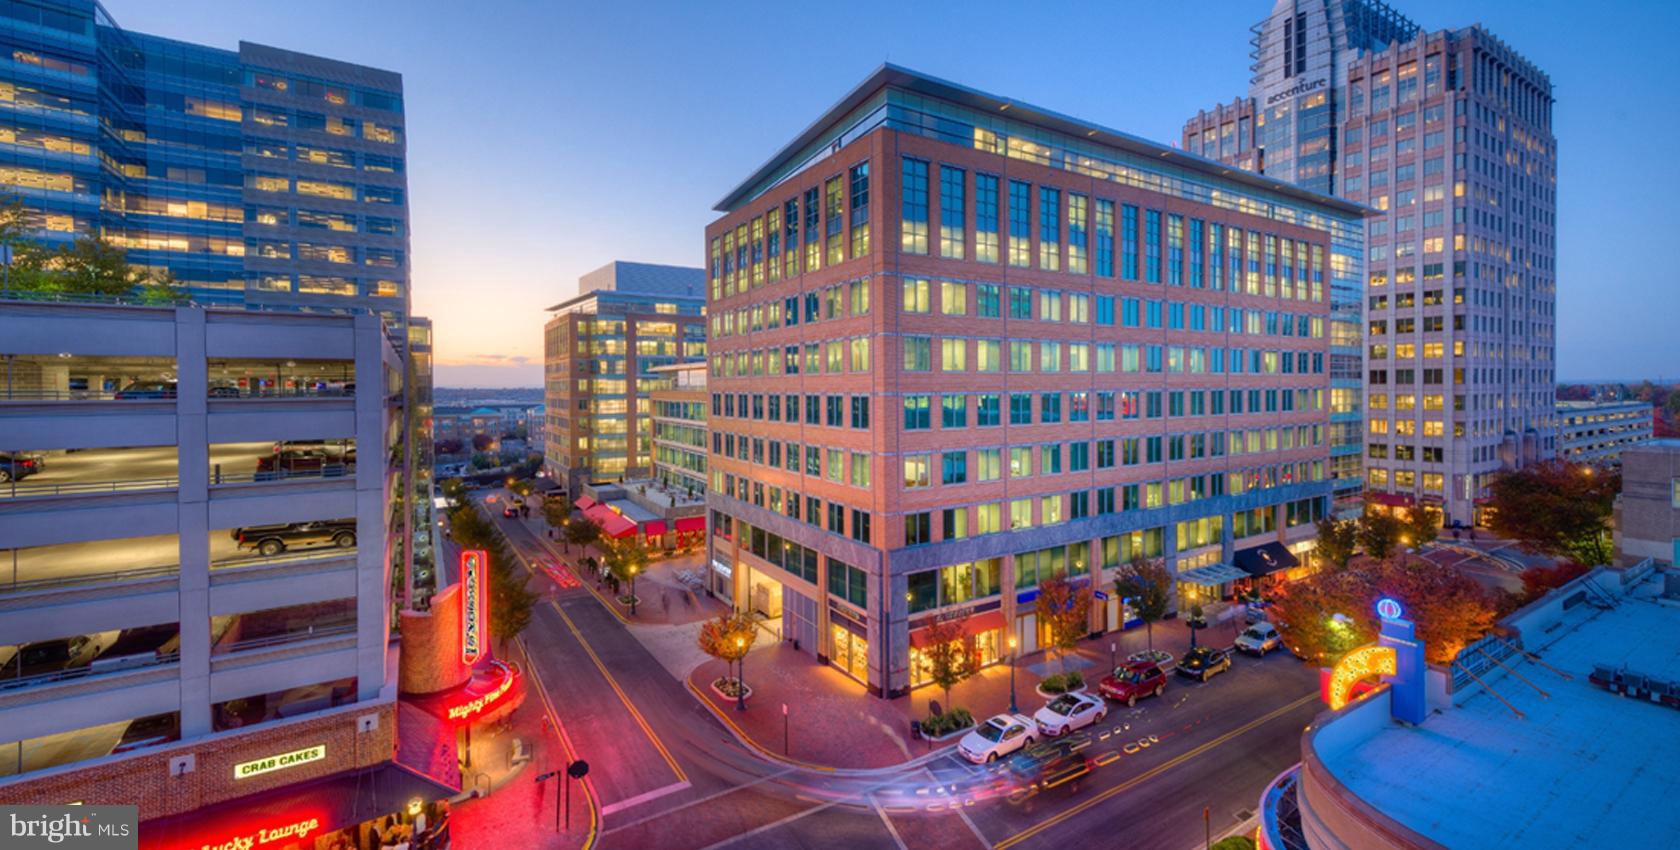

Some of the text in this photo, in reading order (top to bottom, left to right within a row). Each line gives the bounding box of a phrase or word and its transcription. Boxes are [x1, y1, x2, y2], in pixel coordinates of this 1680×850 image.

[1267, 78, 1326, 104] accenture
[448, 700, 484, 719] Mighty
[242, 749, 319, 774] CRAB CAKES
[258, 818, 319, 844] Lounge
